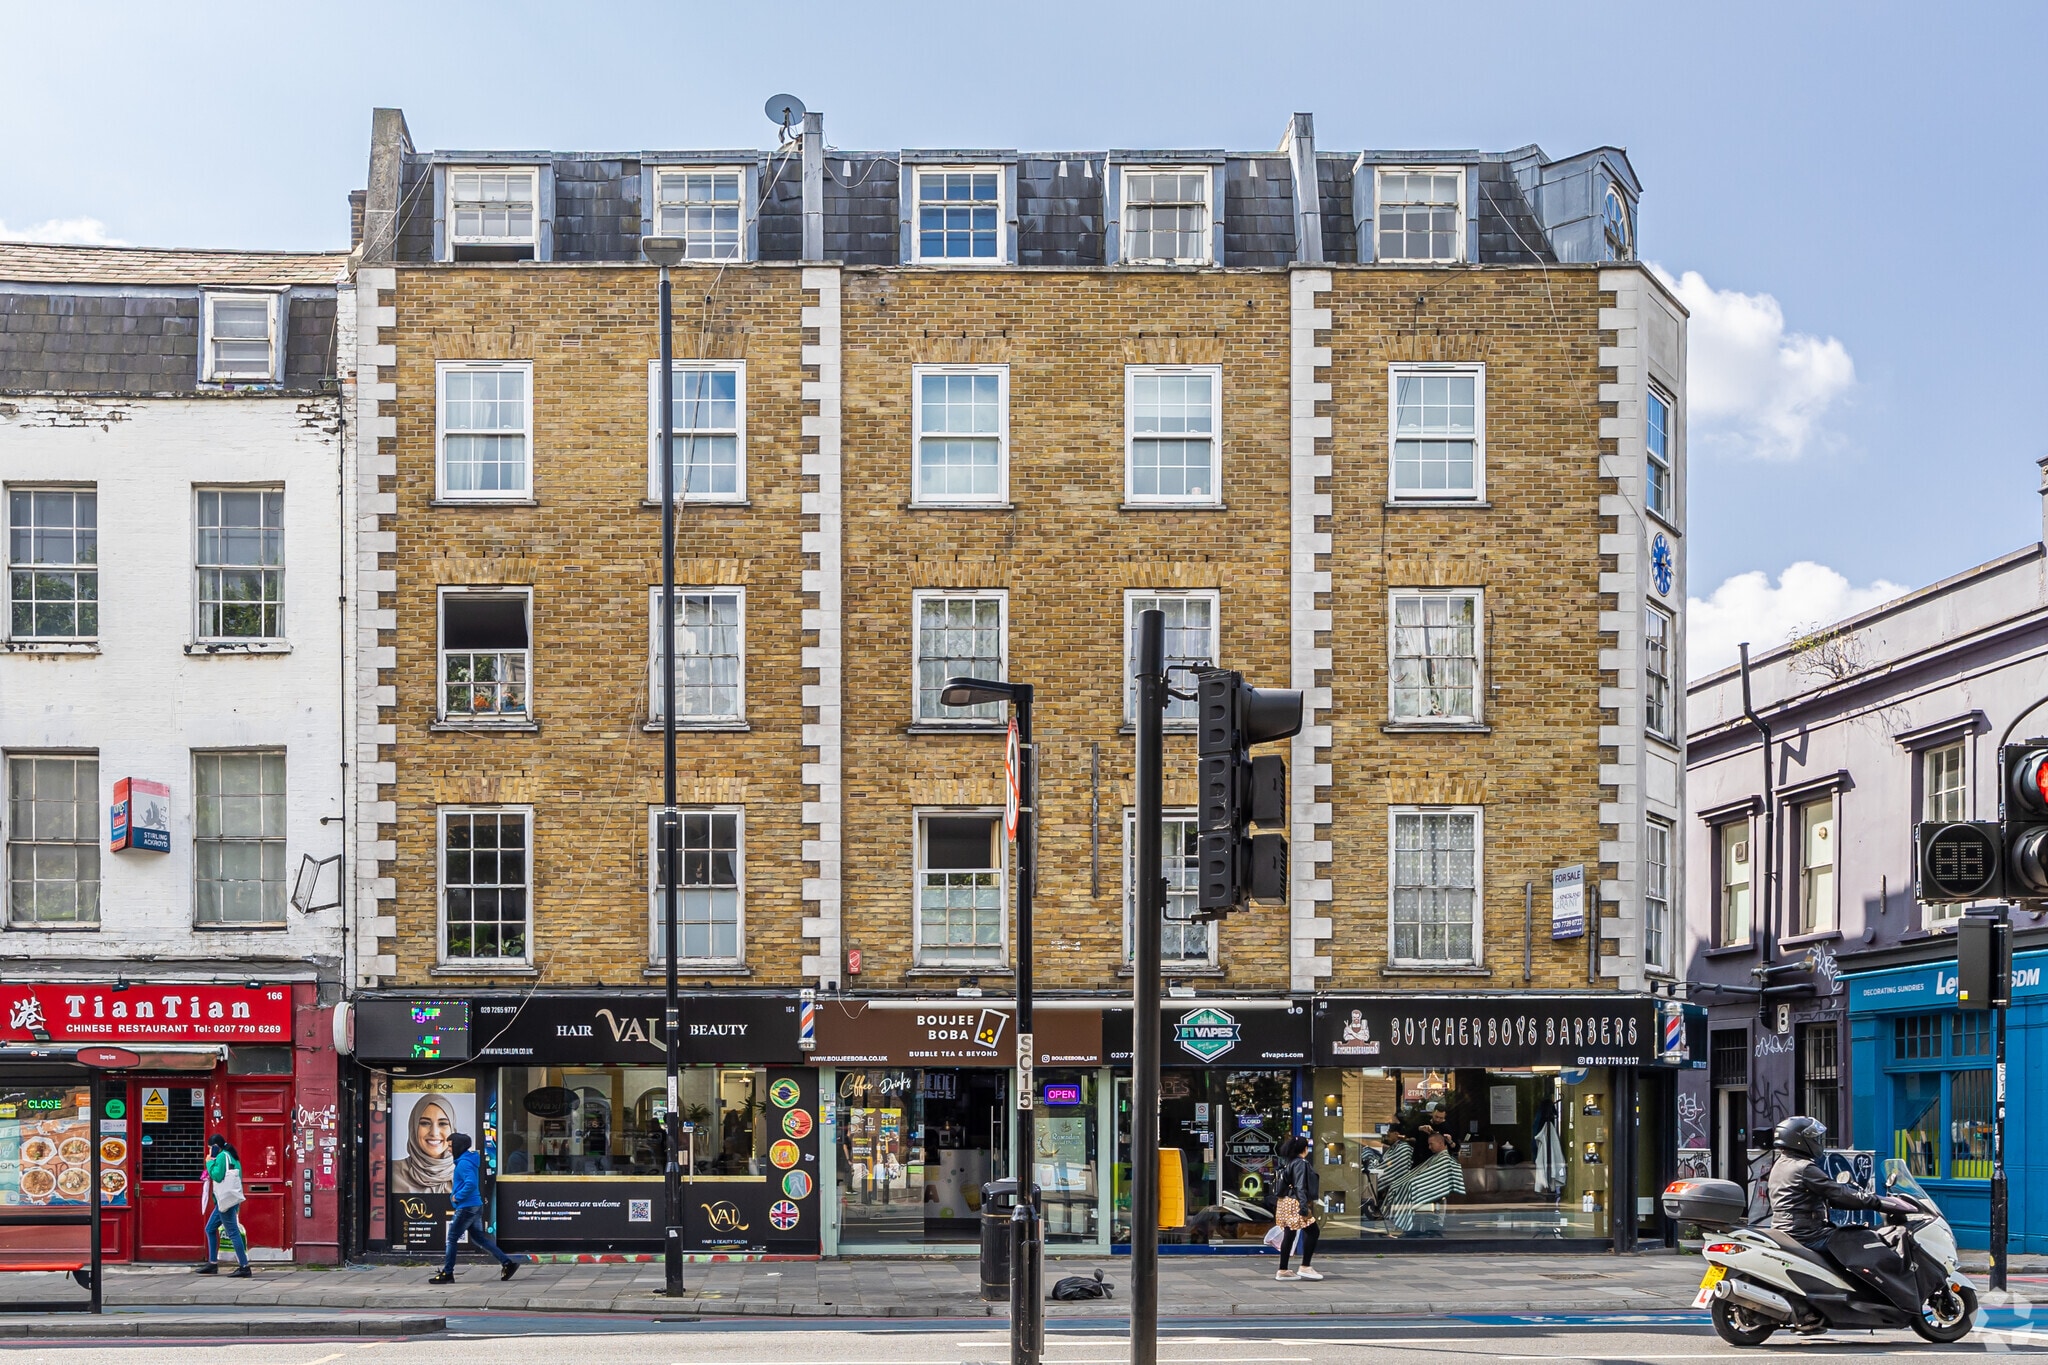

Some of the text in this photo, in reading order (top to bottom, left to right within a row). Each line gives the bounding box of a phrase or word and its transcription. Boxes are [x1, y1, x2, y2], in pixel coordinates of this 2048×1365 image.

[144, 831, 168, 840] STIRLING
[144, 840, 168, 848] ACKROYD
[1555, 870, 1581, 883] FOR SALE
[1863, 983, 1925, 997] DECORATING SUNDRIES
[266, 992, 283, 1000] 166
[481, 1006, 491, 1014] 020
[917, 1015, 975, 1026] BOUJEE
[66, 1024, 281, 1034] CHINESE RESTAURANT Tel: 0207 790 6269
[556, 1008, 748, 1052] HAIR VAL BEAUTY
[1545, 1017, 1638, 1048] BARBERS
[928, 1030, 969, 1040] BOBA
[1261, 1051, 1304, 1060] e1vapes.com
[1595, 1056, 1607, 1065] 020
[1624, 1056, 1639, 1065] 3137
[840, 1072, 873, 1098] Coffee
[879, 1071, 912, 1094] Drinks
[1048, 1090, 1077, 1099] OPEN
[27, 1099, 62, 1110] CLOSE
[1244, 1145, 1270, 1153] VAPES
[400, 1199, 433, 1219] VAL
[517, 1199, 545, 1209] Walk-in
[546, 1200, 580, 1208] customers
[591, 1199, 621, 1208] welcome
[700, 1203, 749, 1231] VAL
